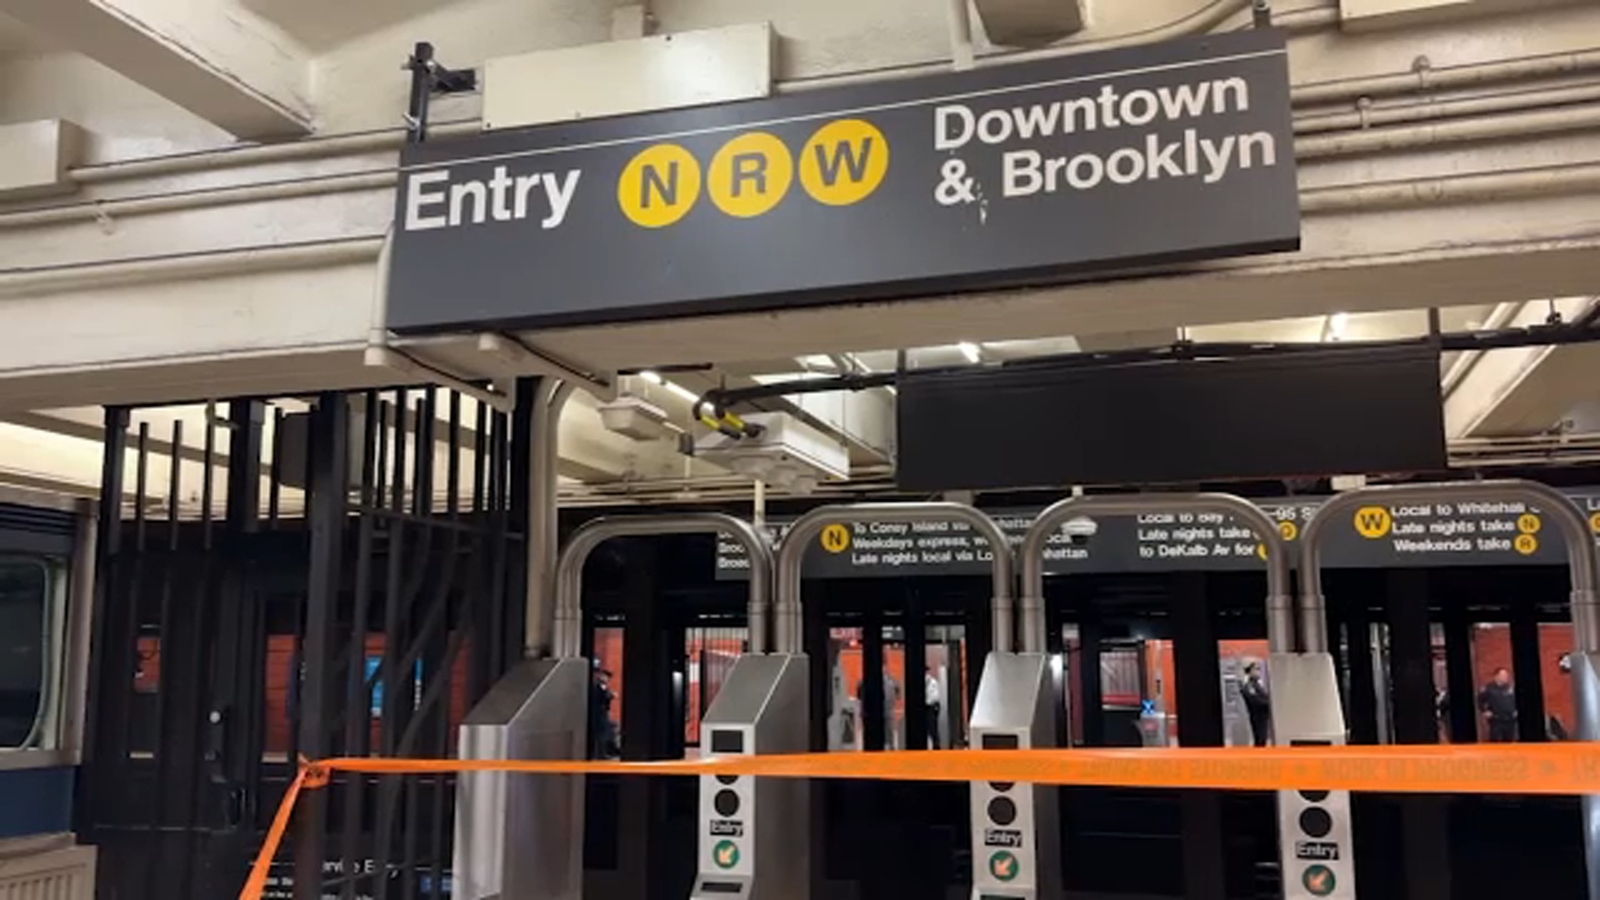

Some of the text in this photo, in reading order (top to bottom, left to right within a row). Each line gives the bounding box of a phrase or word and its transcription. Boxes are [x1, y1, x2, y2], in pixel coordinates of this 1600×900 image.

[935, 77, 1249, 151] Downtown
[934, 130, 1276, 206] & Brooklyn
[404, 137, 874, 231] Entry N R W
[1361, 513, 1383, 531] W
[1391, 504, 1431, 517] Local
[1437, 504, 1452, 516] to
[853, 522, 867, 534] To
[869, 521, 908, 536] Coney
[912, 520, 948, 532] Island
[1138, 527, 1250, 543] Late nights take
[1391, 521, 1426, 535] Late
[1430, 520, 1475, 536] nights
[1480, 519, 1515, 532] take
[852, 537, 913, 550] Weekdays
[917, 534, 970, 549] express,
[1140, 542, 1255, 558] to DeKalb Av for
[1394, 538, 1471, 551] Weekends
[1477, 537, 1511, 550] take
[852, 552, 879, 565] Late
[882, 551, 919, 566] nights
[922, 549, 952, 562] local
[955, 549, 974, 560] via
[986, 829, 1022, 847] Entry
[1297, 841, 1338, 859] Entry
